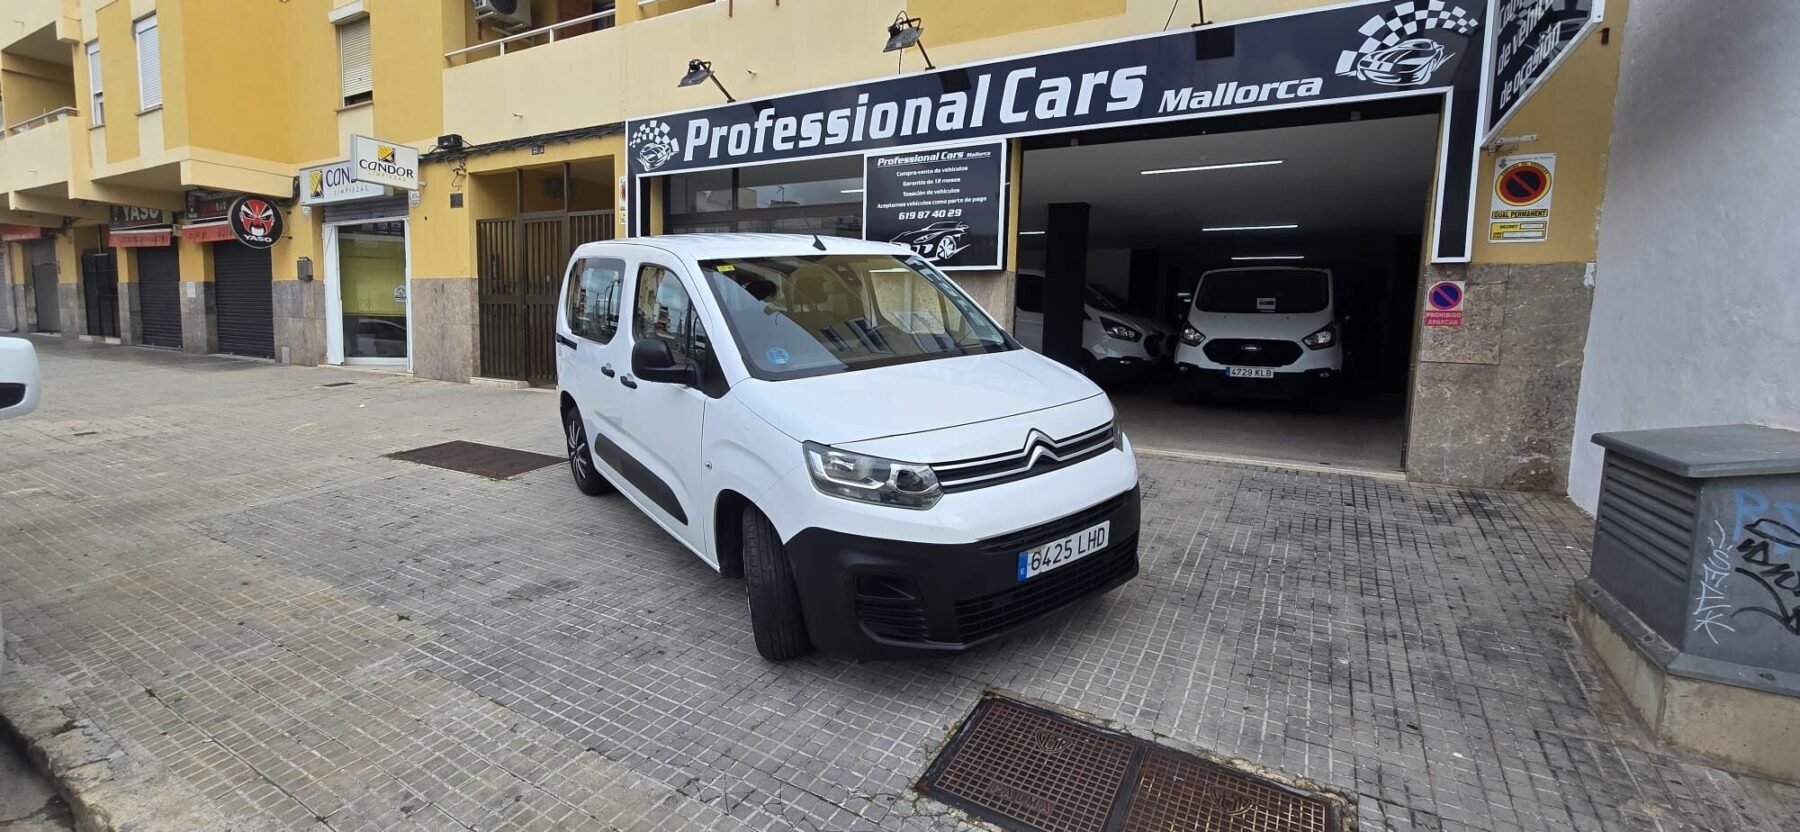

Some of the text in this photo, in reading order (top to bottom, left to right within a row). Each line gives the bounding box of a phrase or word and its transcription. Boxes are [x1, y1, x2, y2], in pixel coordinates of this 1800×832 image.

[1498, 42, 1512, 76] de
[1500, 21, 1561, 110] de ocasión
[683, 65, 1324, 162] Professional Cars Mallorca
[877, 152, 939, 166] Professional
[941, 151, 965, 161] Cars
[877, 201, 906, 209] Aceptamos
[947, 197, 963, 205] parte
[898, 208, 962, 221] 619 87 40 29
[243, 234, 273, 243] YASO
[1232, 368, 1272, 377] 4729 KLB
[1031, 527, 1105, 571] 6425 LHD
